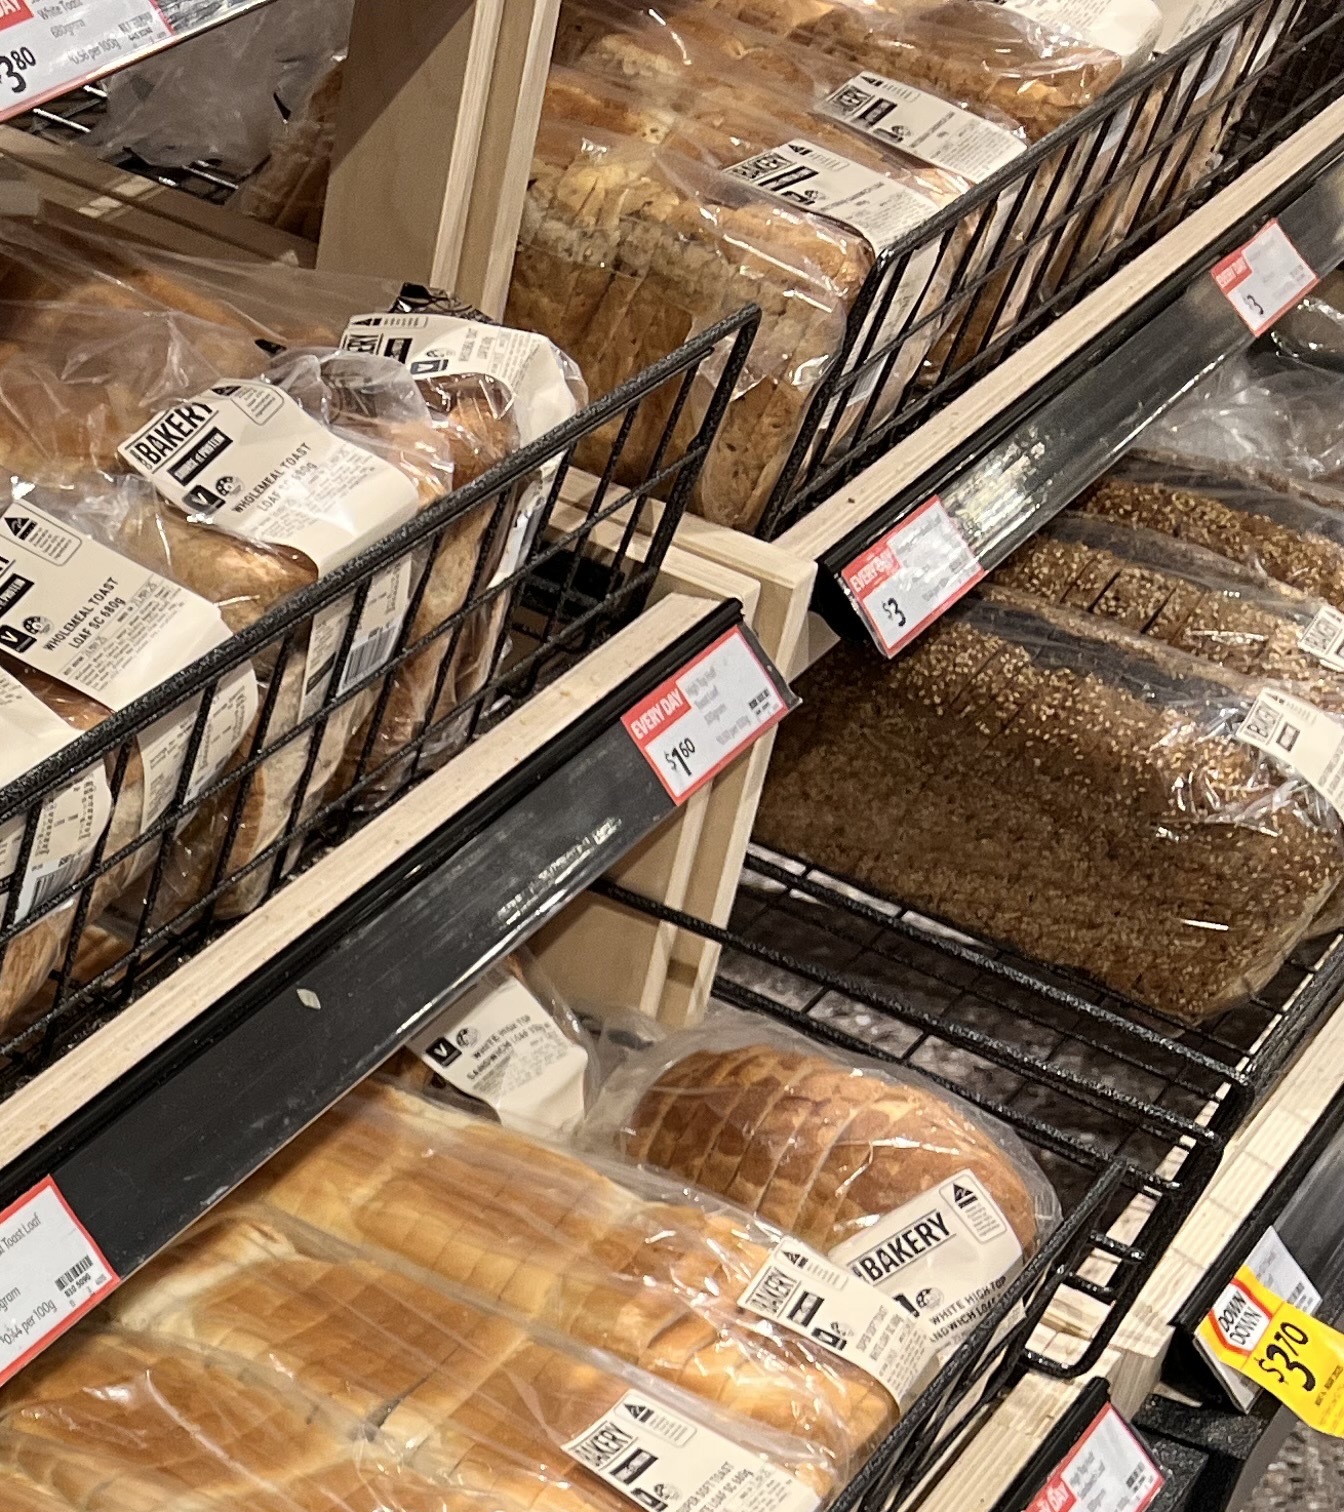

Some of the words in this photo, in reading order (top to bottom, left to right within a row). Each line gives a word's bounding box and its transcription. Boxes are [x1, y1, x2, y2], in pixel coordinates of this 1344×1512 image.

[135, 402, 213, 468] BAKERY
[43, 602, 93, 651] WHOLEMEAL
[89, 577, 120, 607] TOAST
[630, 705, 666, 740] EVERY
[661, 689, 684, 717] DAY
[1, 1226, 25, 1249] Toast
[22, 1212, 41, 1234] Loaf
[860, 1212, 950, 1281] BAKERY
[22, 1315, 36, 1338] per
[34, 1298, 57, 1322] 100g
[1218, 1290, 1247, 1332] DOWN
[1229, 1306, 1263, 1345] DOWN
